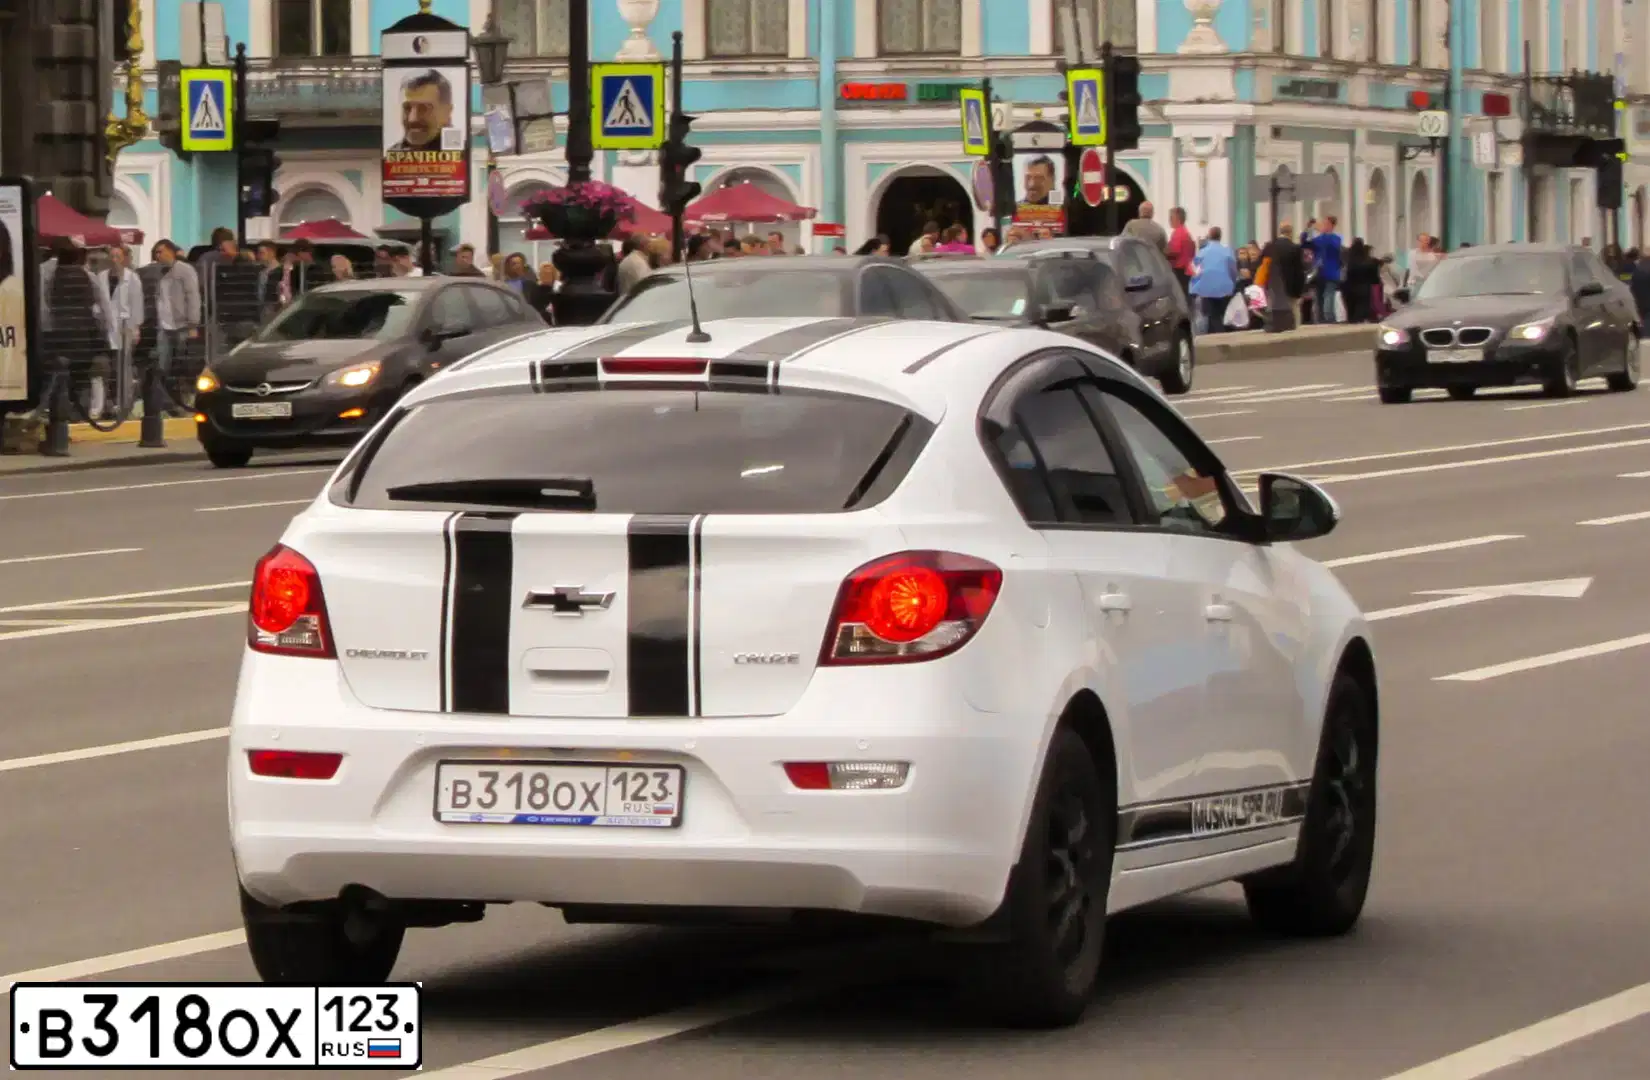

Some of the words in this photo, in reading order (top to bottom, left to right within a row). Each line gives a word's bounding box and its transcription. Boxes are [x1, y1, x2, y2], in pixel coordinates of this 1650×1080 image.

[387, 151, 463, 162] БРАЧНОЕ
[346, 648, 429, 661] CHEVROLET
[733, 652, 800, 665] CRUZE
[612, 771, 669, 802] 123
[623, 803, 652, 814] RUS
